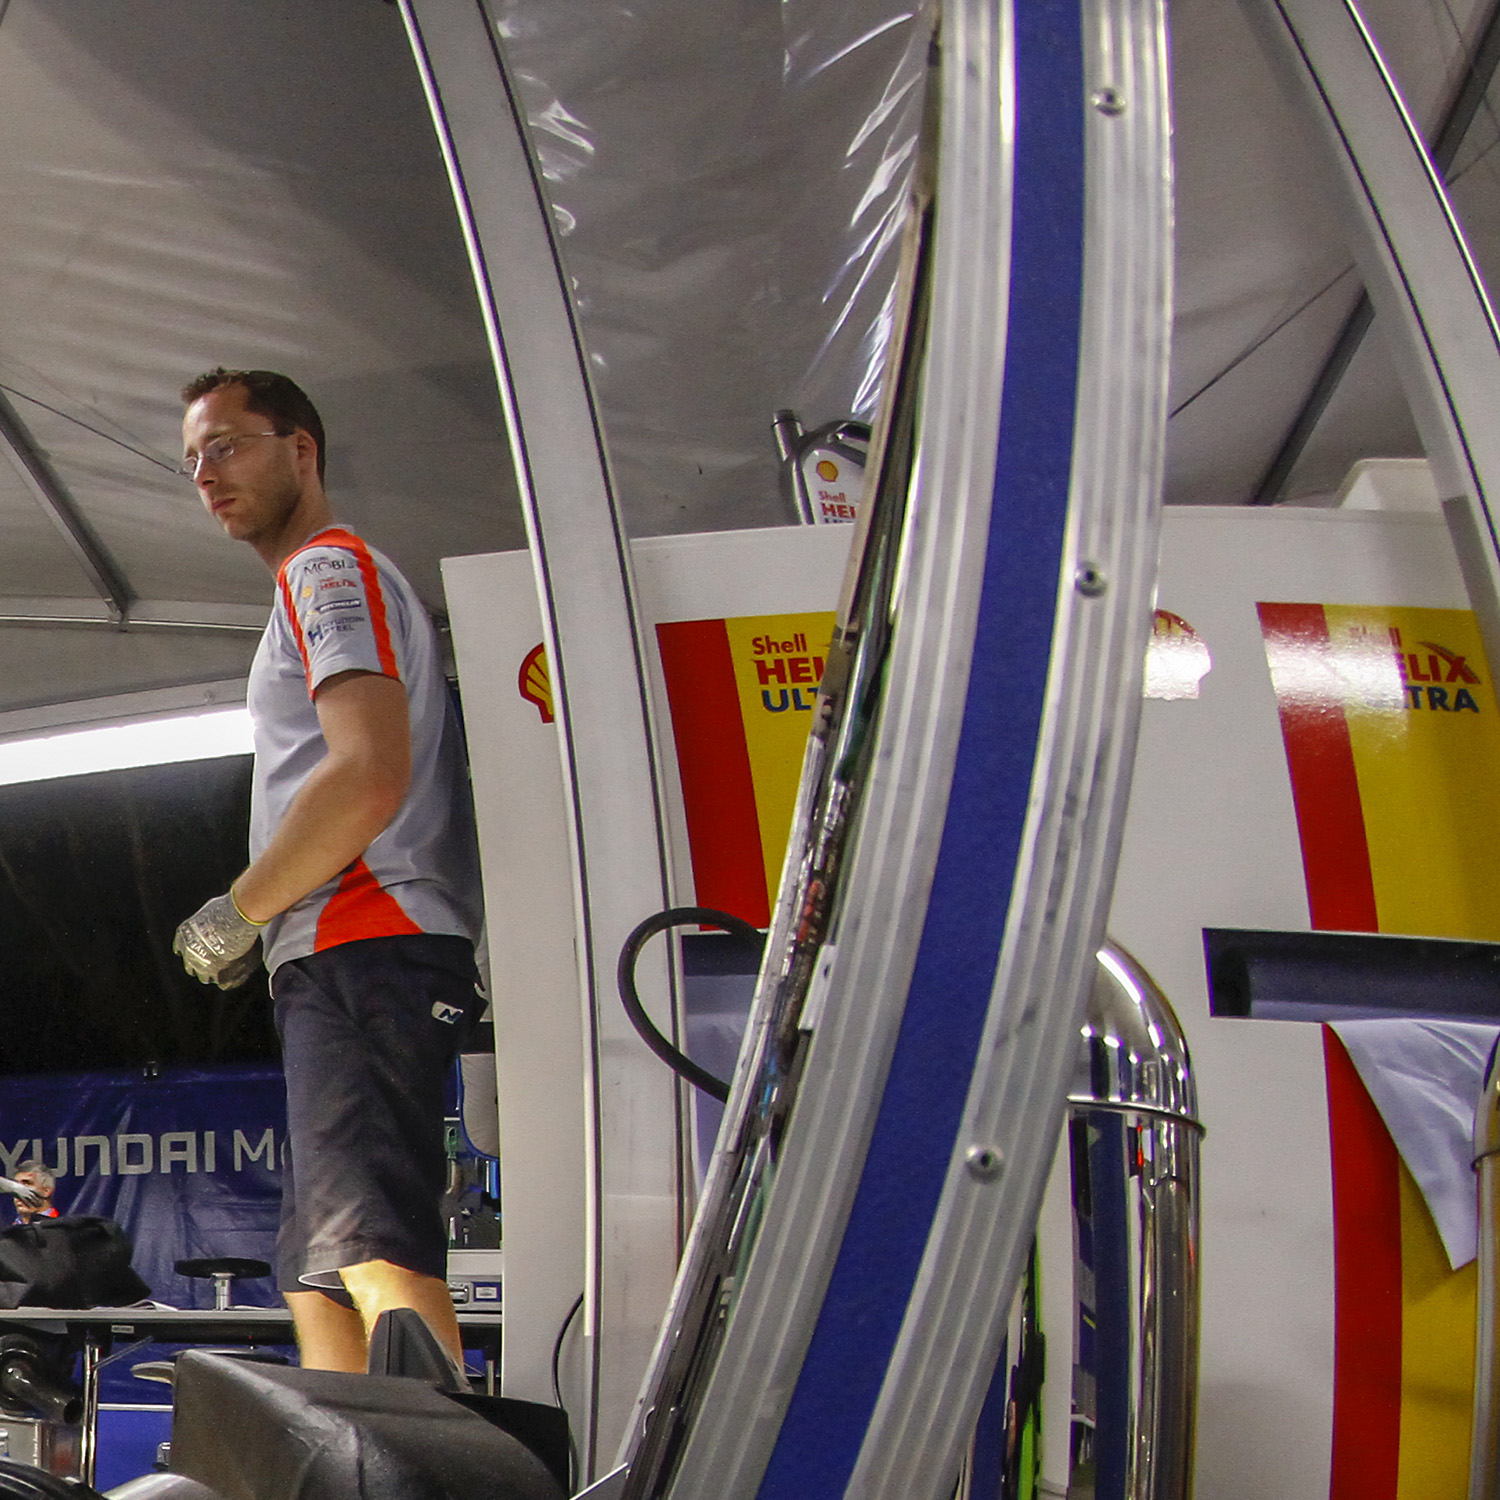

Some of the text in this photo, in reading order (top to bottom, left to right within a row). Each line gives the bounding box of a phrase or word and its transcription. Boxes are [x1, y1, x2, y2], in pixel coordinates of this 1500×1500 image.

[819, 491, 846, 502] Shell
[752, 633, 807, 655] Shell
[1394, 641, 1481, 684] LIX
[233, 1128, 287, 1172] M
